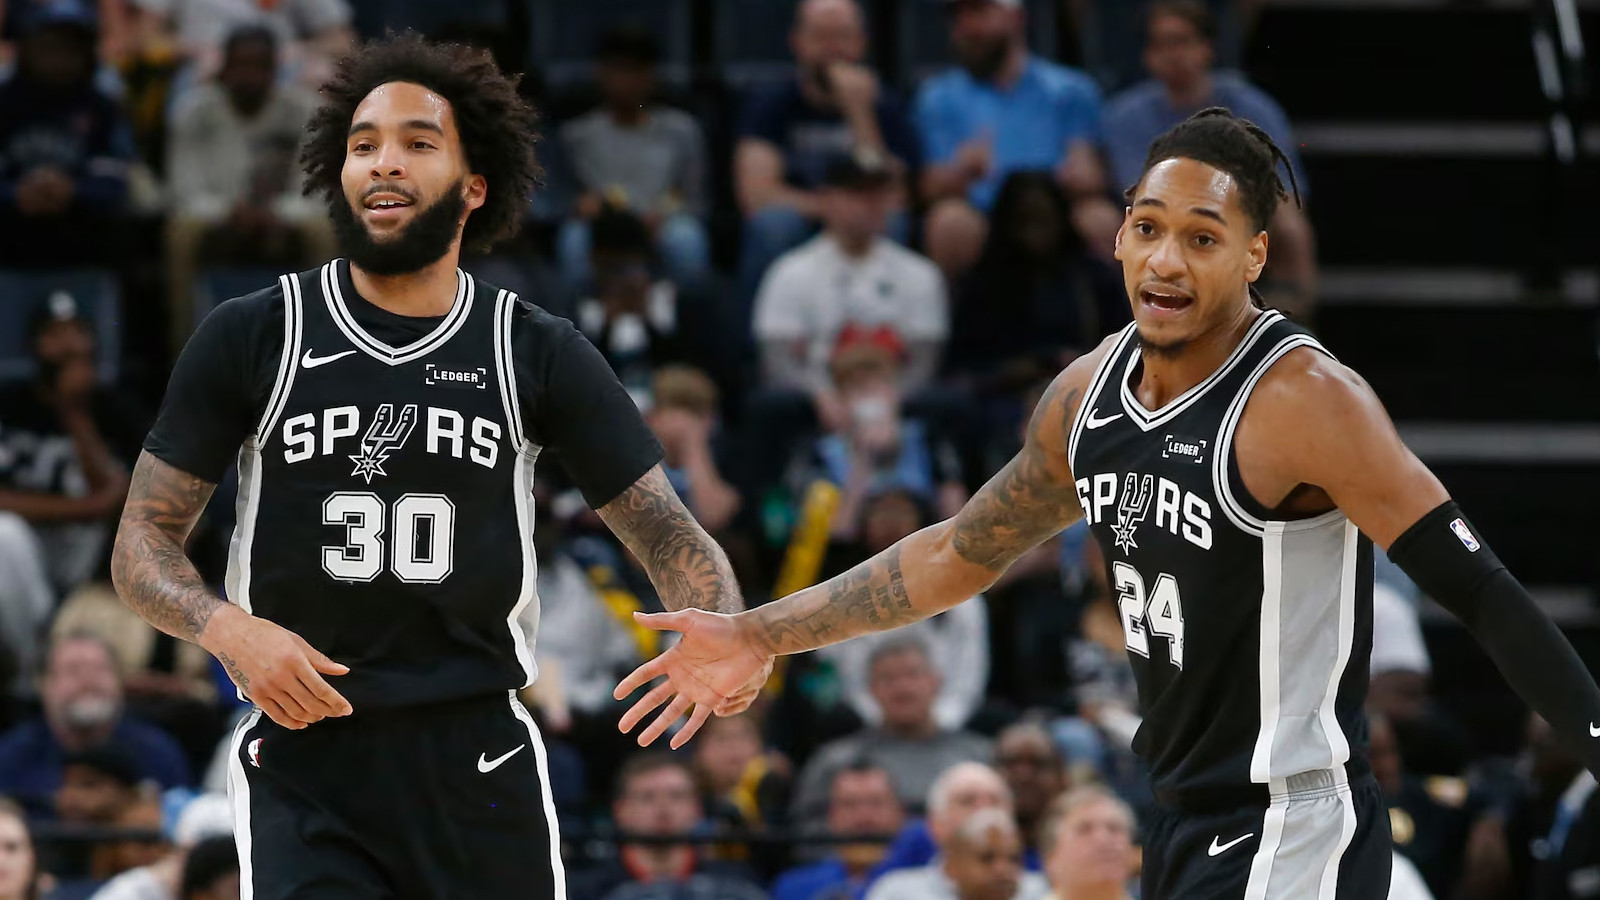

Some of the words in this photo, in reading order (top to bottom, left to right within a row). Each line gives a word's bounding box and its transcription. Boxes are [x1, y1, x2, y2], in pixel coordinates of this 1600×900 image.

[433, 369, 479, 383] LEDGER
[282, 403, 502, 484] SPURS
[1168, 441, 1200, 457] LEDGER
[321, 491, 456, 584] 30
[1075, 472, 1213, 556] SPURS
[1112, 560, 1185, 672] 24
